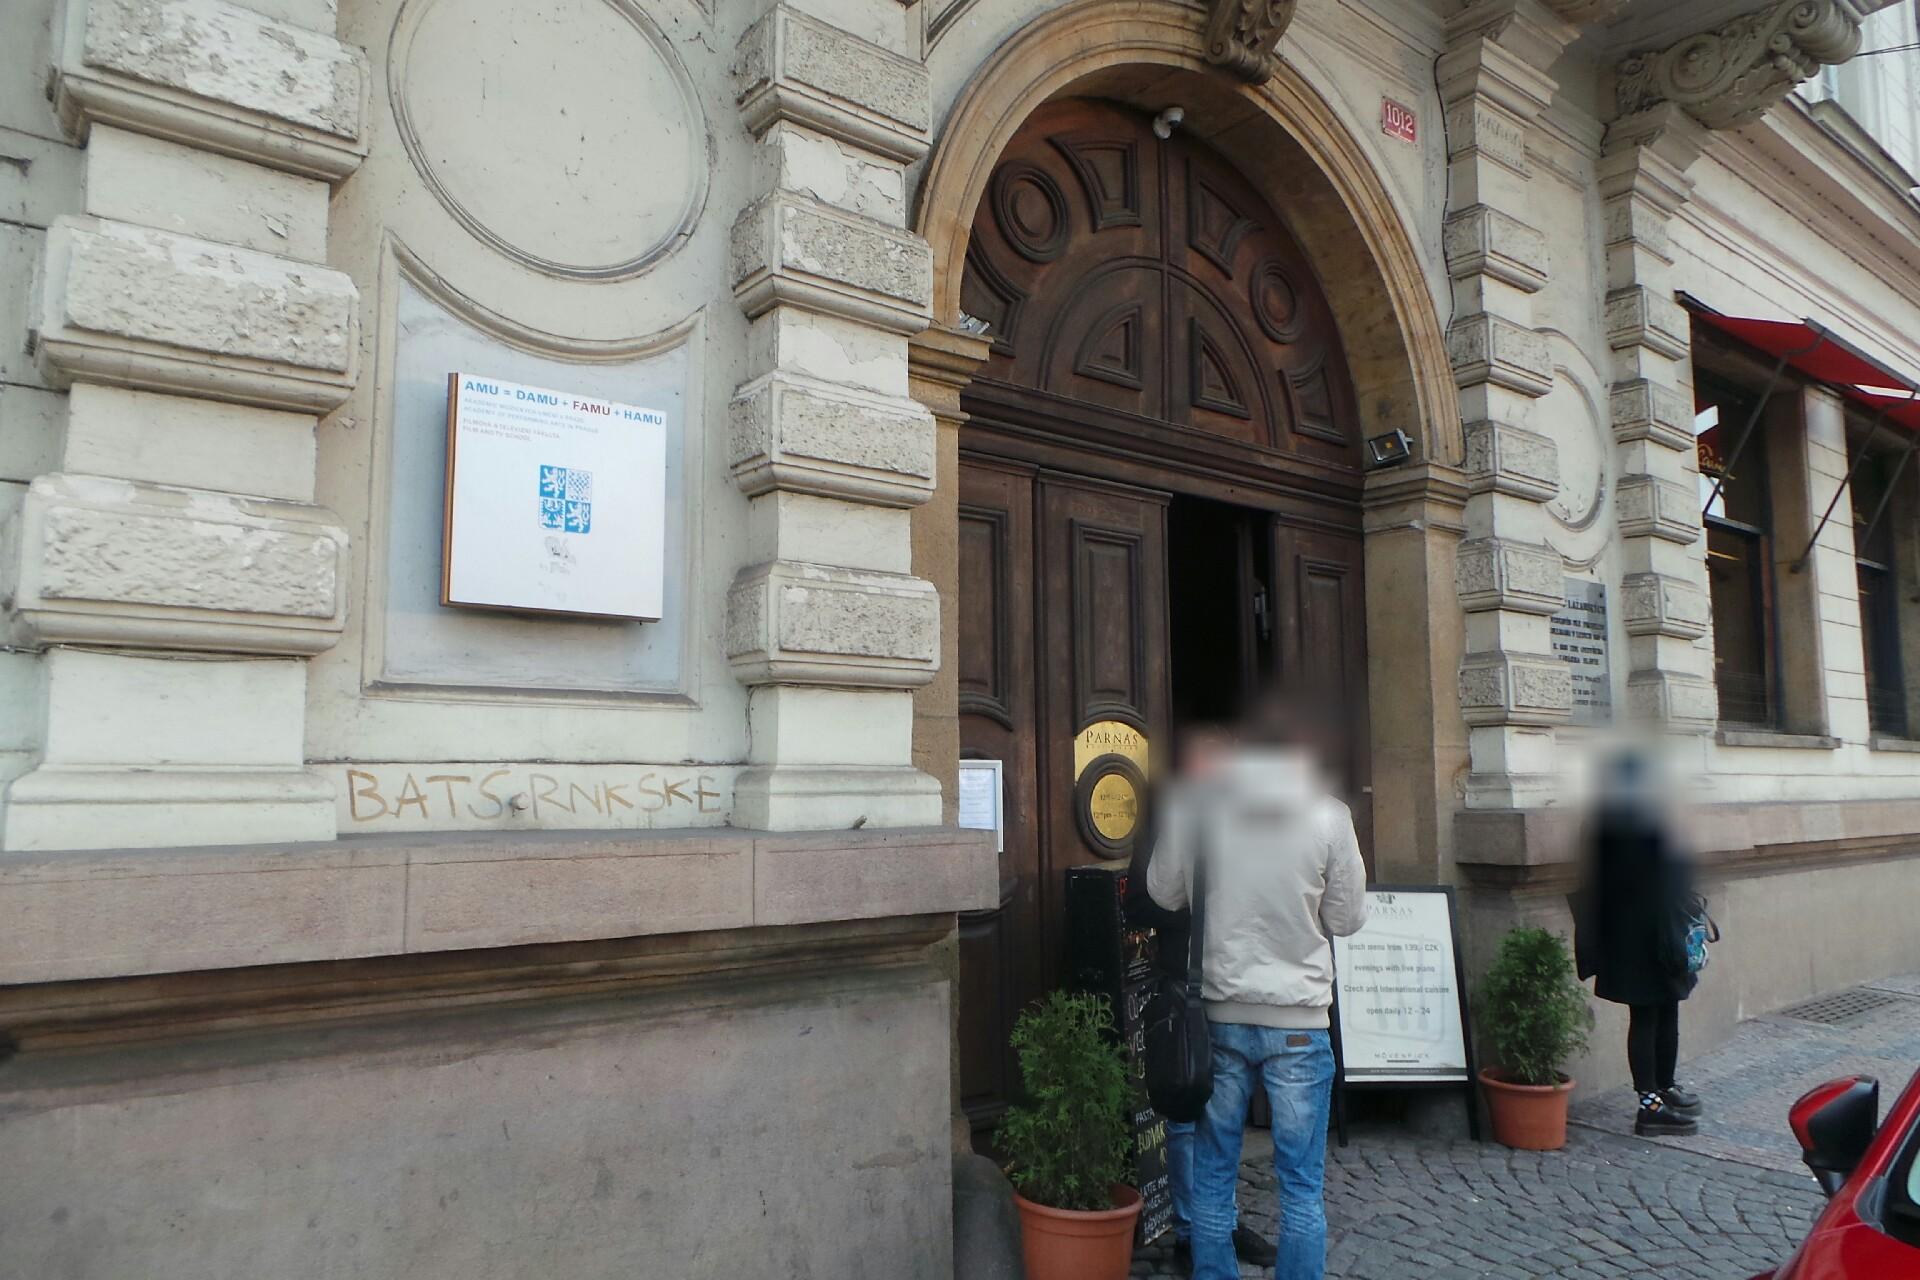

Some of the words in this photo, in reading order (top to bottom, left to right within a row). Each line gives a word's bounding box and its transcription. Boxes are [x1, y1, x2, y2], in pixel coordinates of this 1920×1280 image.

[1387, 104, 1414, 134] 1012
[465, 381, 498, 395] AMU
[516, 389, 558, 406] DAMU
[573, 400, 611, 416] FAMU
[624, 409, 662, 426] HAMU
[1086, 730, 1138, 744] PARNAS
[1344, 984, 1364, 992] Czech
[1366, 1007, 1383, 1015] open
